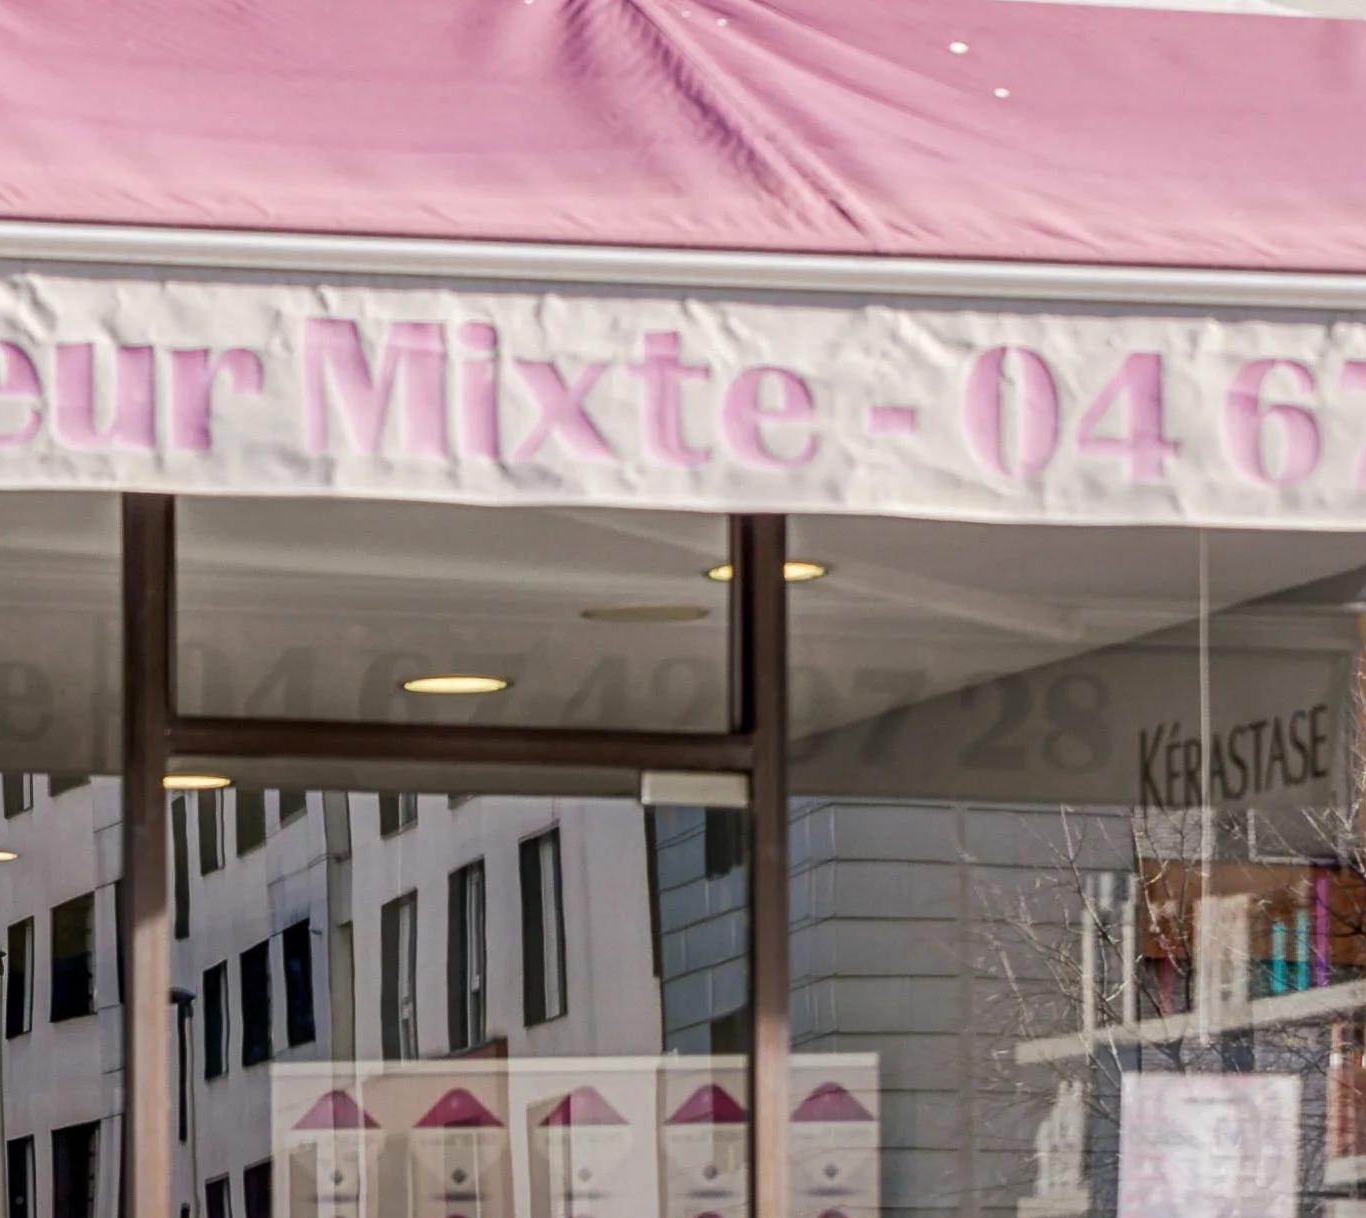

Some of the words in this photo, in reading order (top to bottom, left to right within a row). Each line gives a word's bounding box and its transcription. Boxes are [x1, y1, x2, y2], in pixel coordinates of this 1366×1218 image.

[301, 317, 820, 470] Mixte
[864, 402, 917, 438] -
[962, 345, 1181, 484] 04
[1138, 703, 1328, 812] KÉRASTASE
